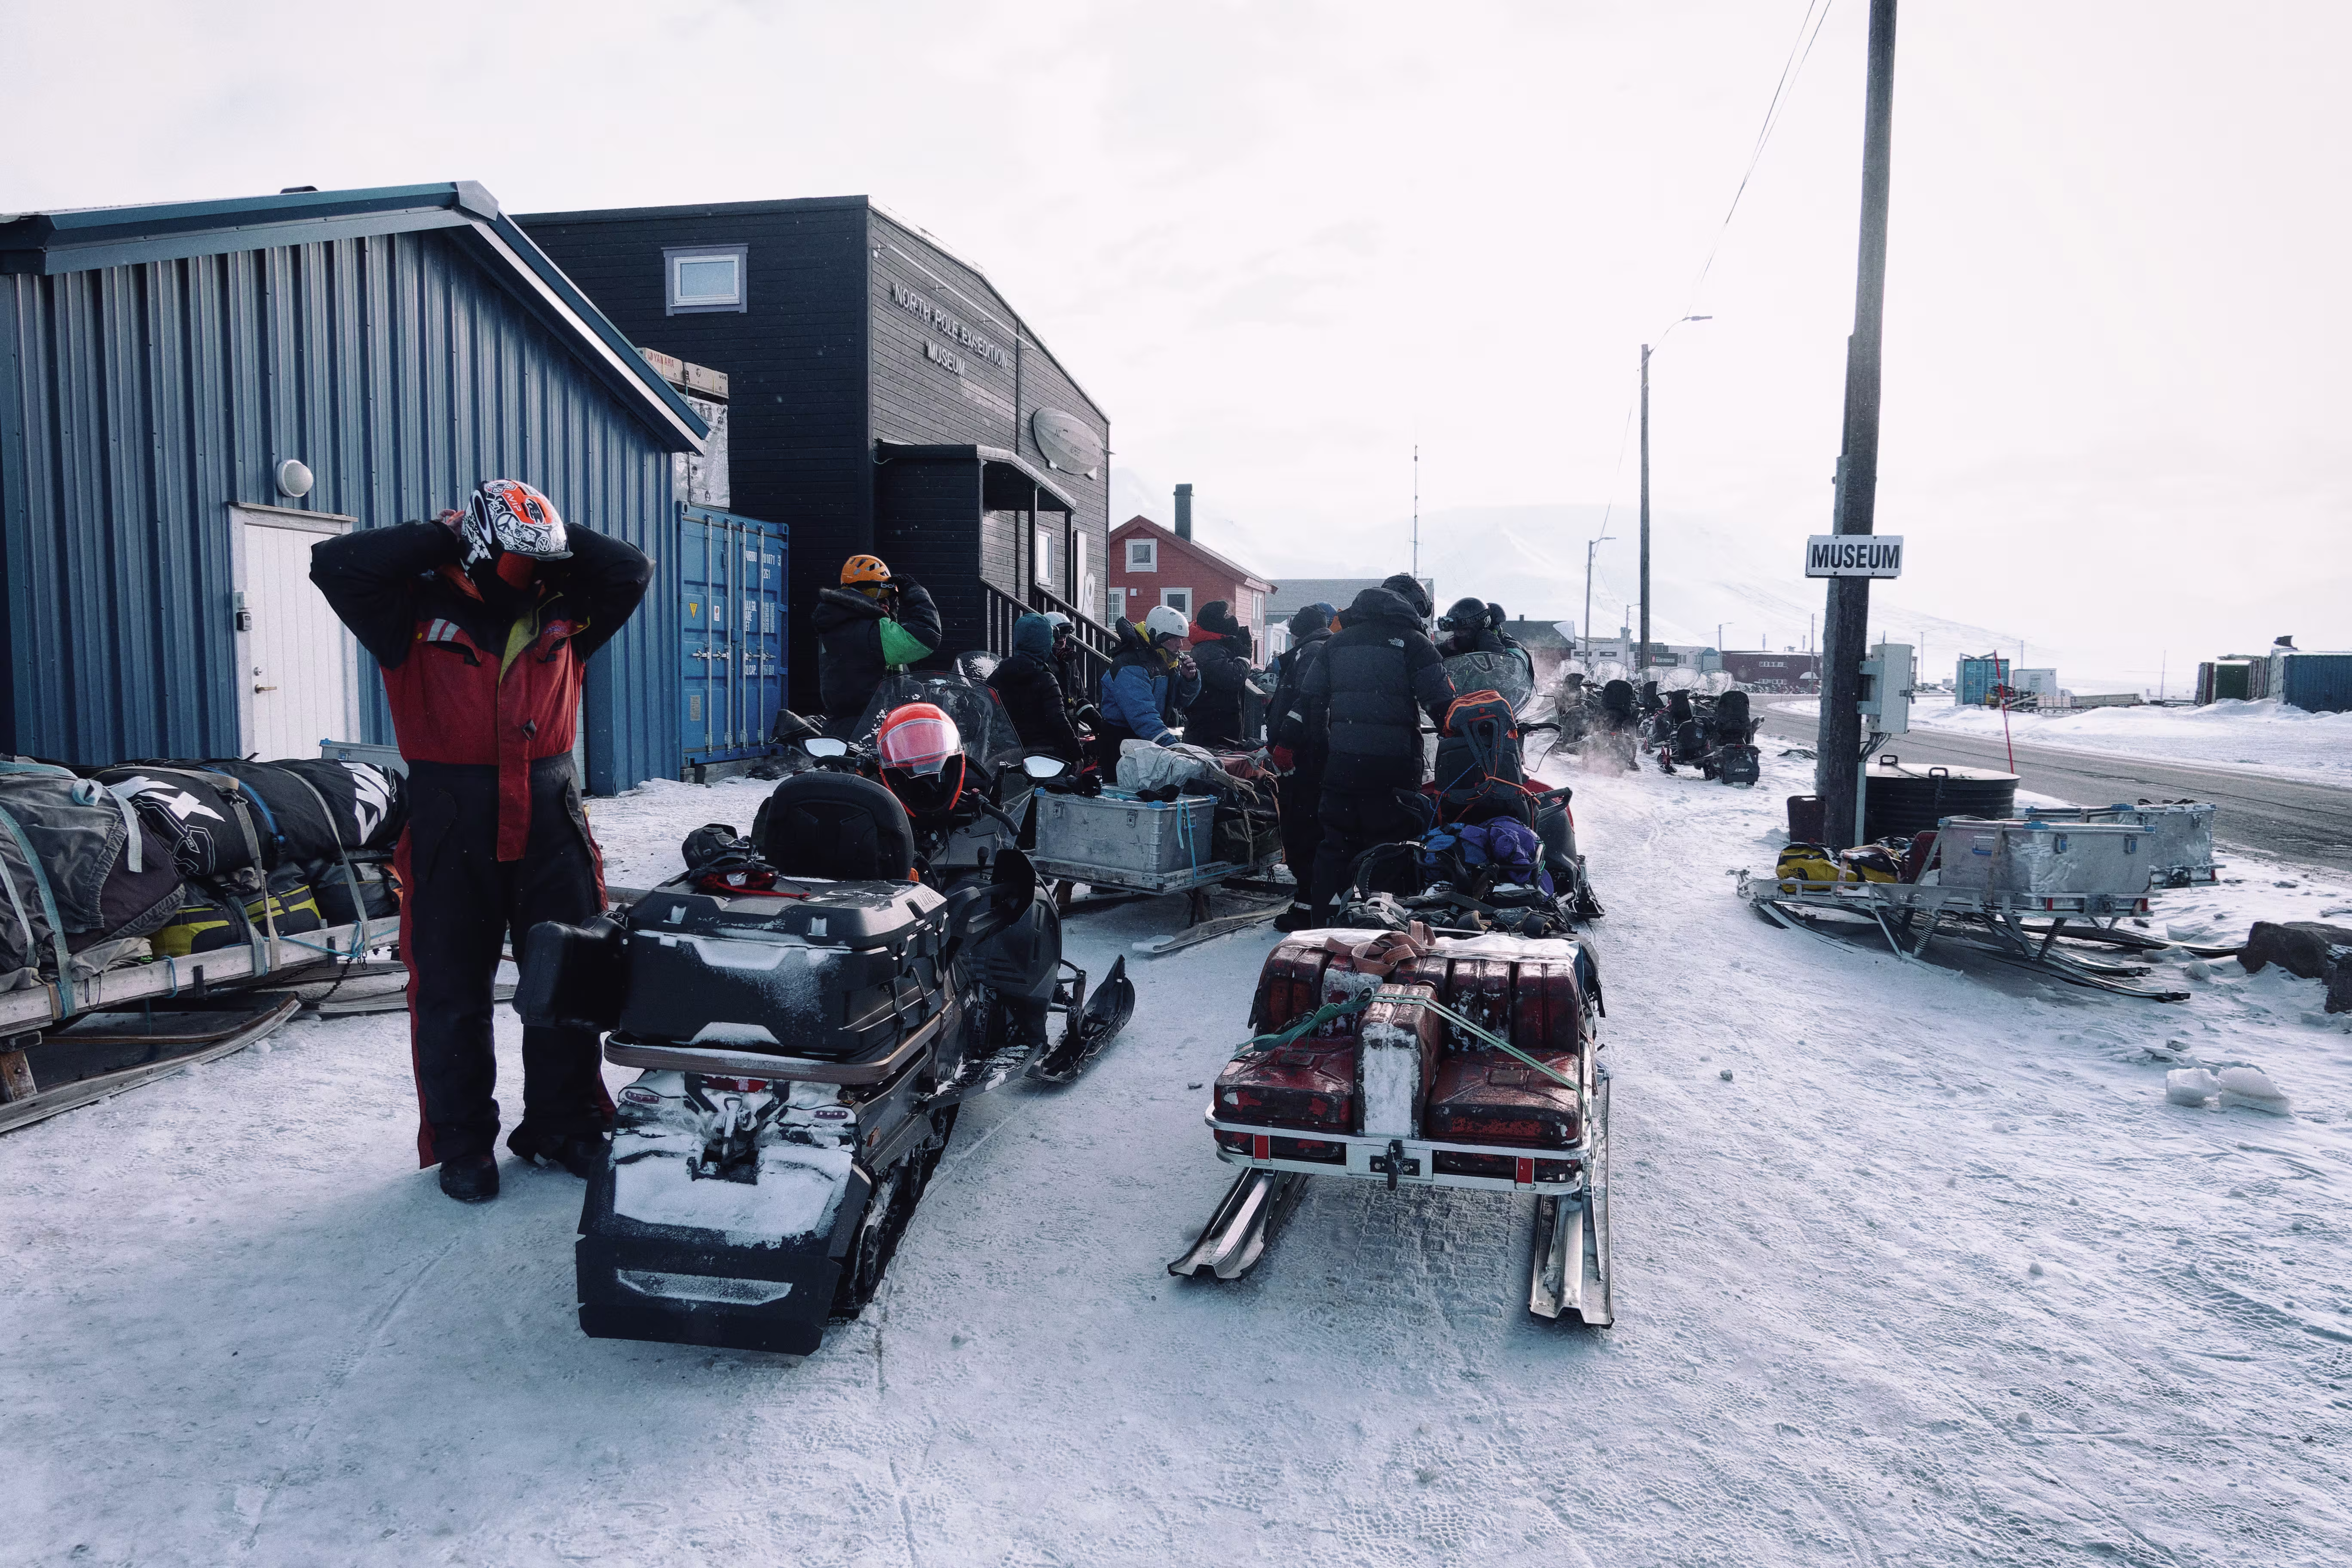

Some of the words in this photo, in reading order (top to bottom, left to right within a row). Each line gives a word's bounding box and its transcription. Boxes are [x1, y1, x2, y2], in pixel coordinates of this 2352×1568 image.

[894, 282, 931, 322] NORTH
[934, 309, 959, 340] POLE
[962, 326, 1008, 369] EXPEDITION
[927, 340, 965, 377] MUSEUM
[763, 553, 775, 565] 01871
[1811, 544, 1900, 569] MUSEUM
